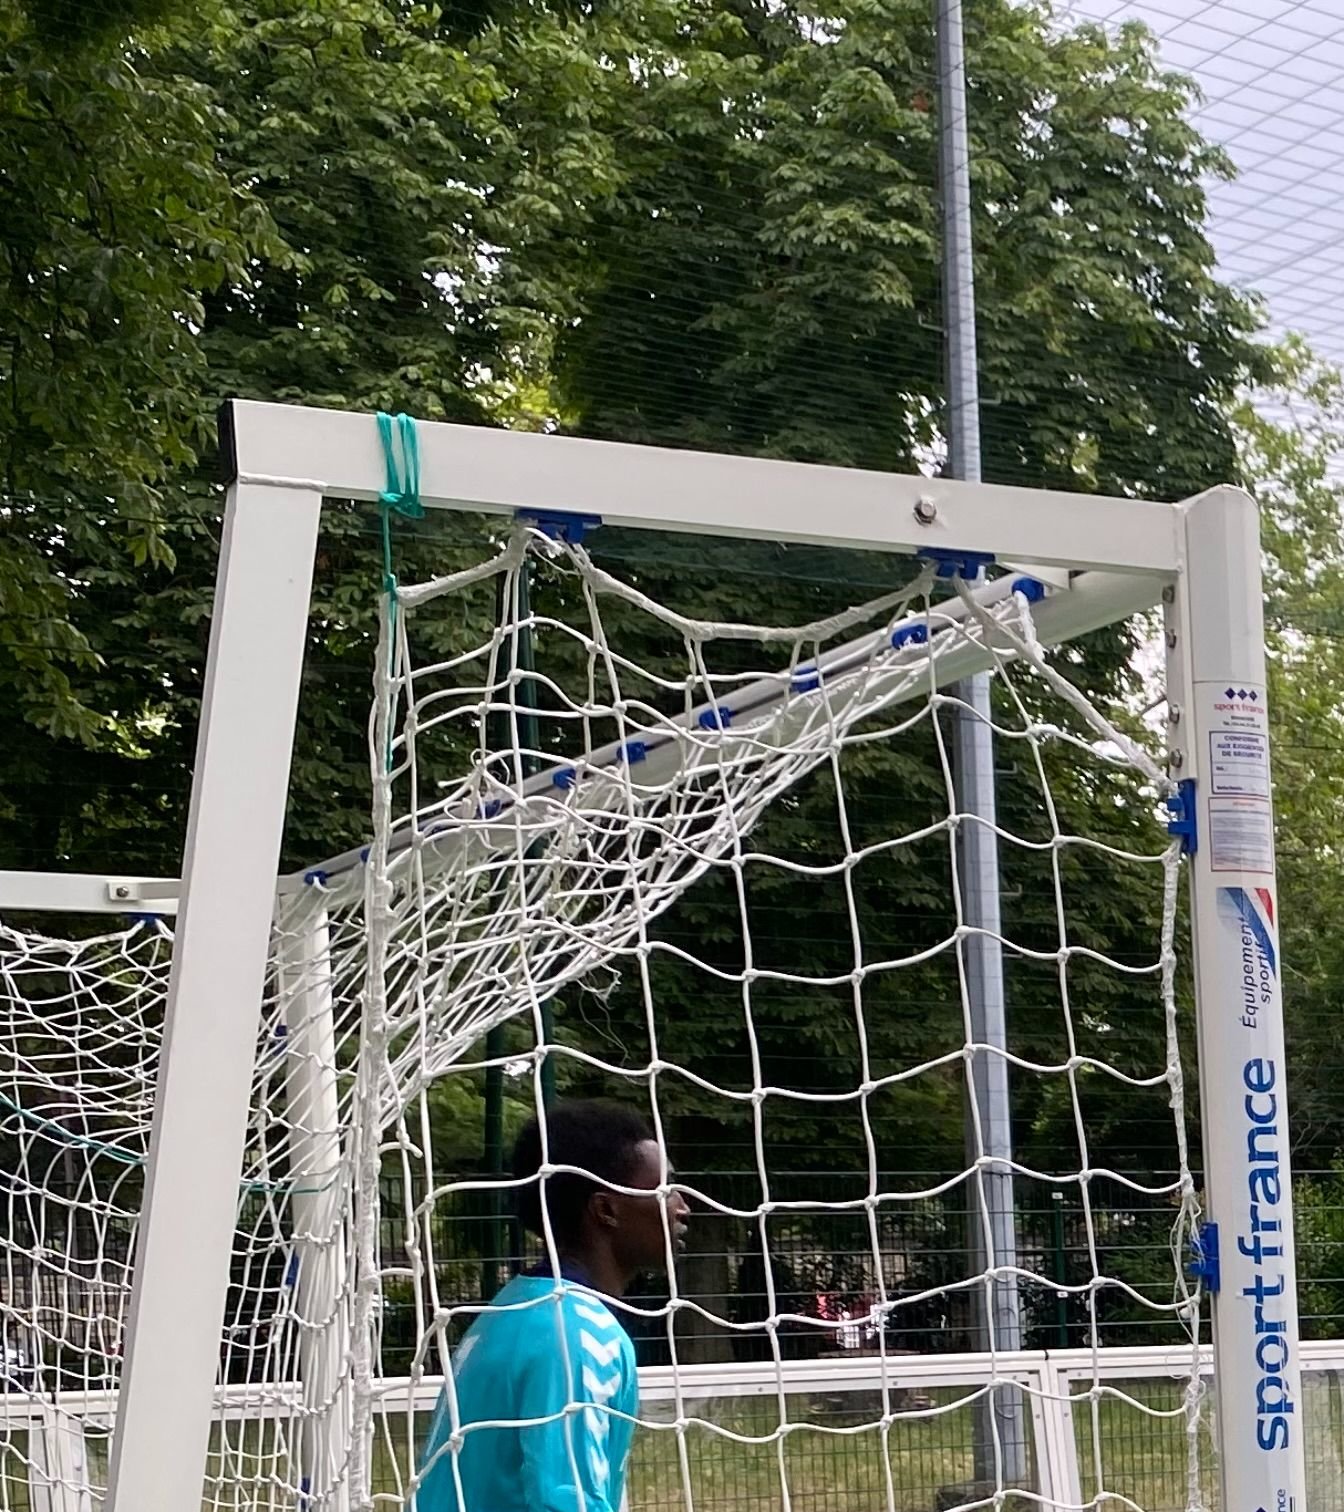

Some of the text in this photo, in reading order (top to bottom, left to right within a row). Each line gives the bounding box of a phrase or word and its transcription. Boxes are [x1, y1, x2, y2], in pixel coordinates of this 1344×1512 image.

[1238, 916, 1259, 1029] Équipement
[1237, 1058, 1294, 1450] sport france
